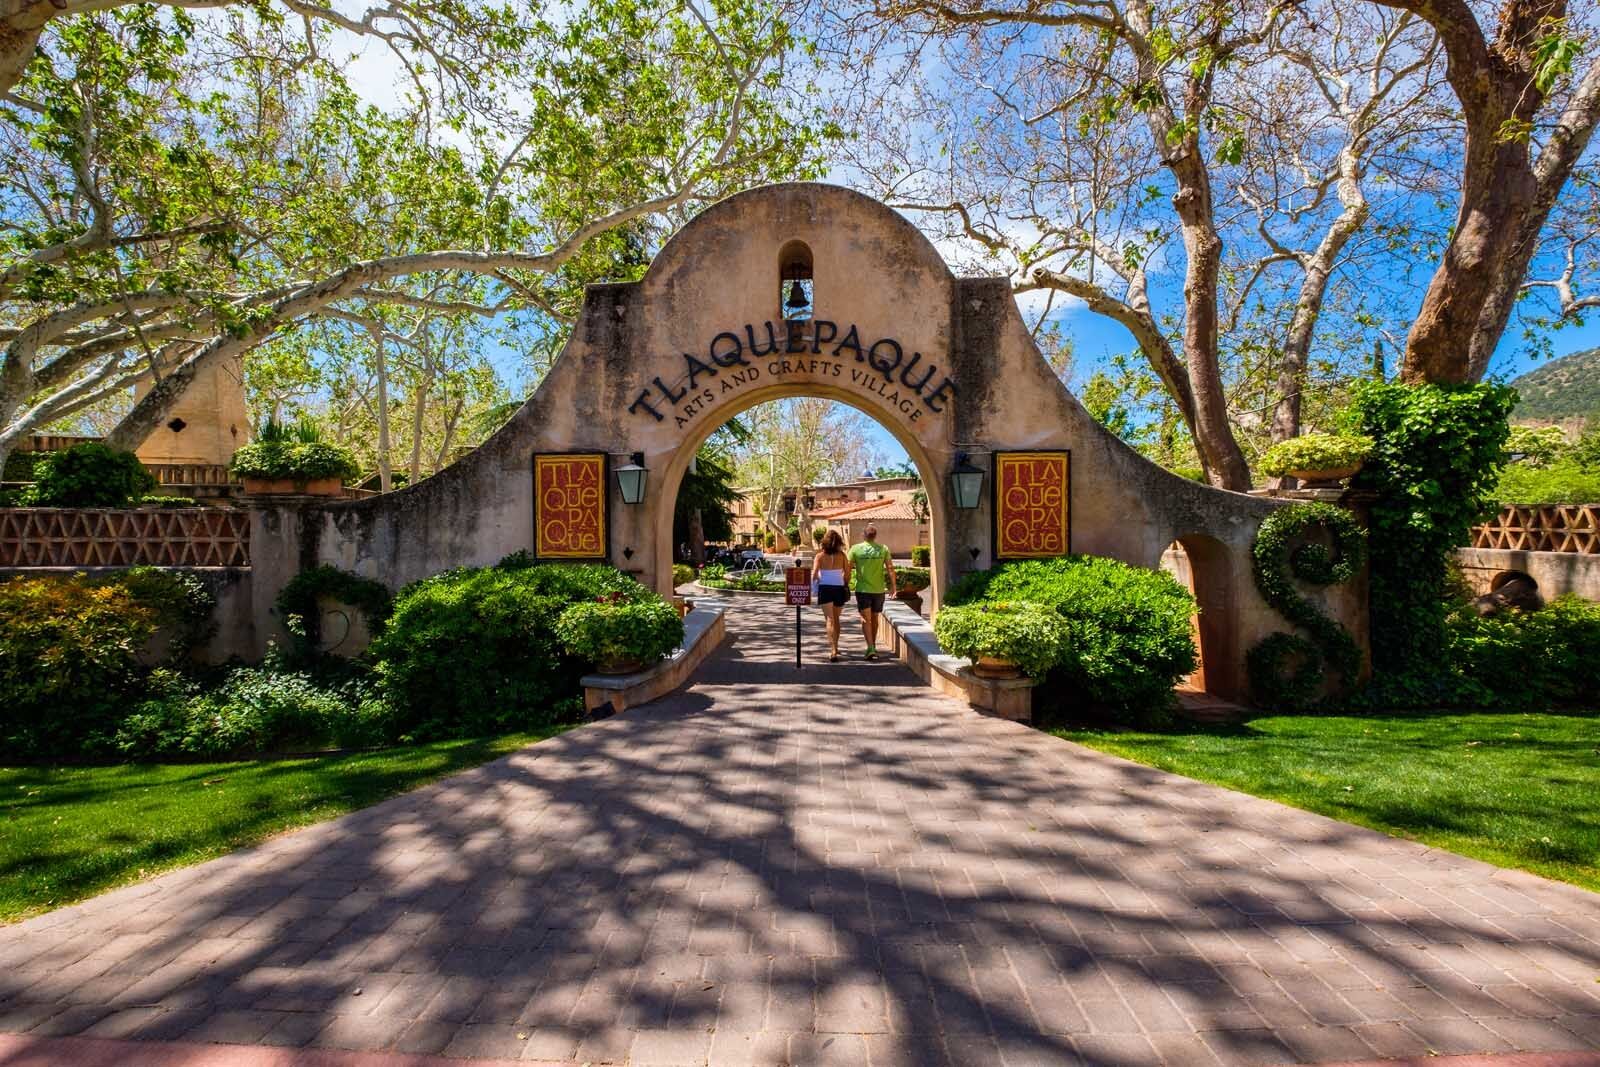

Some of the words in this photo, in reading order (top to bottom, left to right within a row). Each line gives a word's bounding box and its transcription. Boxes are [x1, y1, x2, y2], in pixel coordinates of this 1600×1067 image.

[628, 320, 957, 422] TLAQUEPAQUE
[674, 389, 714, 429] ARTS
[720, 367, 760, 394] AND
[767, 360, 842, 377] CRAFTS
[851, 371, 922, 423] VILLAGE
